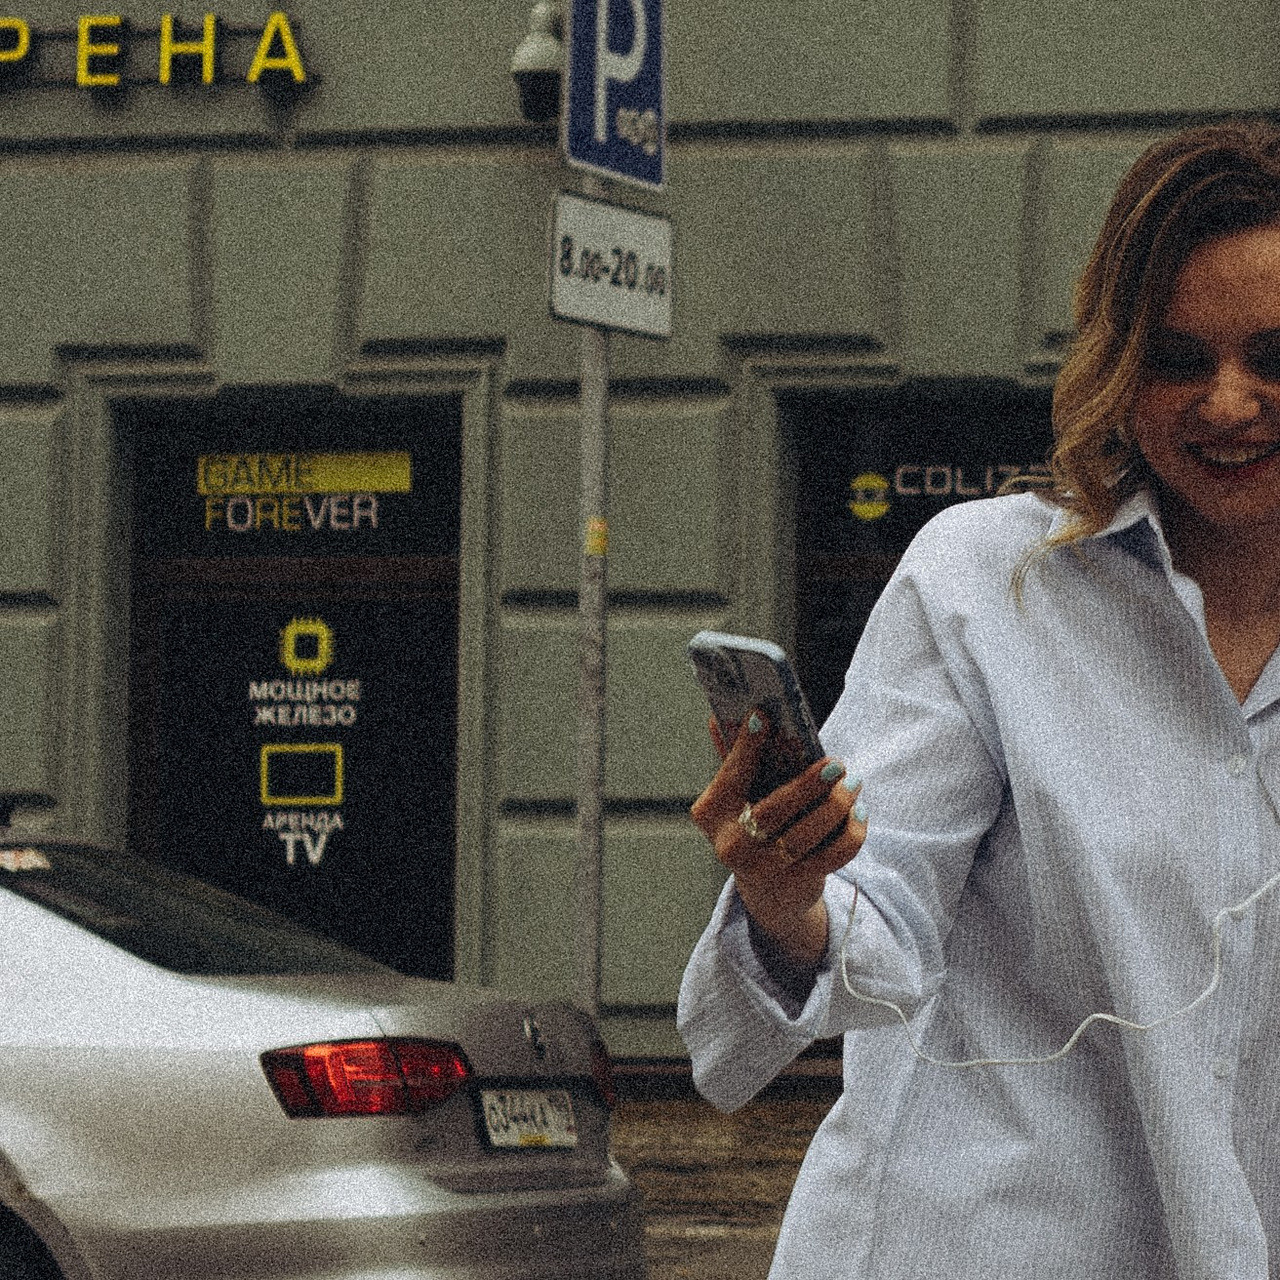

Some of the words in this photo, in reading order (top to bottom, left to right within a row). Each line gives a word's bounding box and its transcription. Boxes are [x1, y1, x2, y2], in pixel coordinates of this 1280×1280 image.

[204, 455, 314, 492] GAME
[205, 495, 380, 531] FOREVER
[248, 680, 361, 703] МОЩНОЕ
[253, 704, 357, 726] ЖЕЛЕЗО
[262, 812, 344, 832] АРЕНДА
[278, 832, 328, 866] TV
